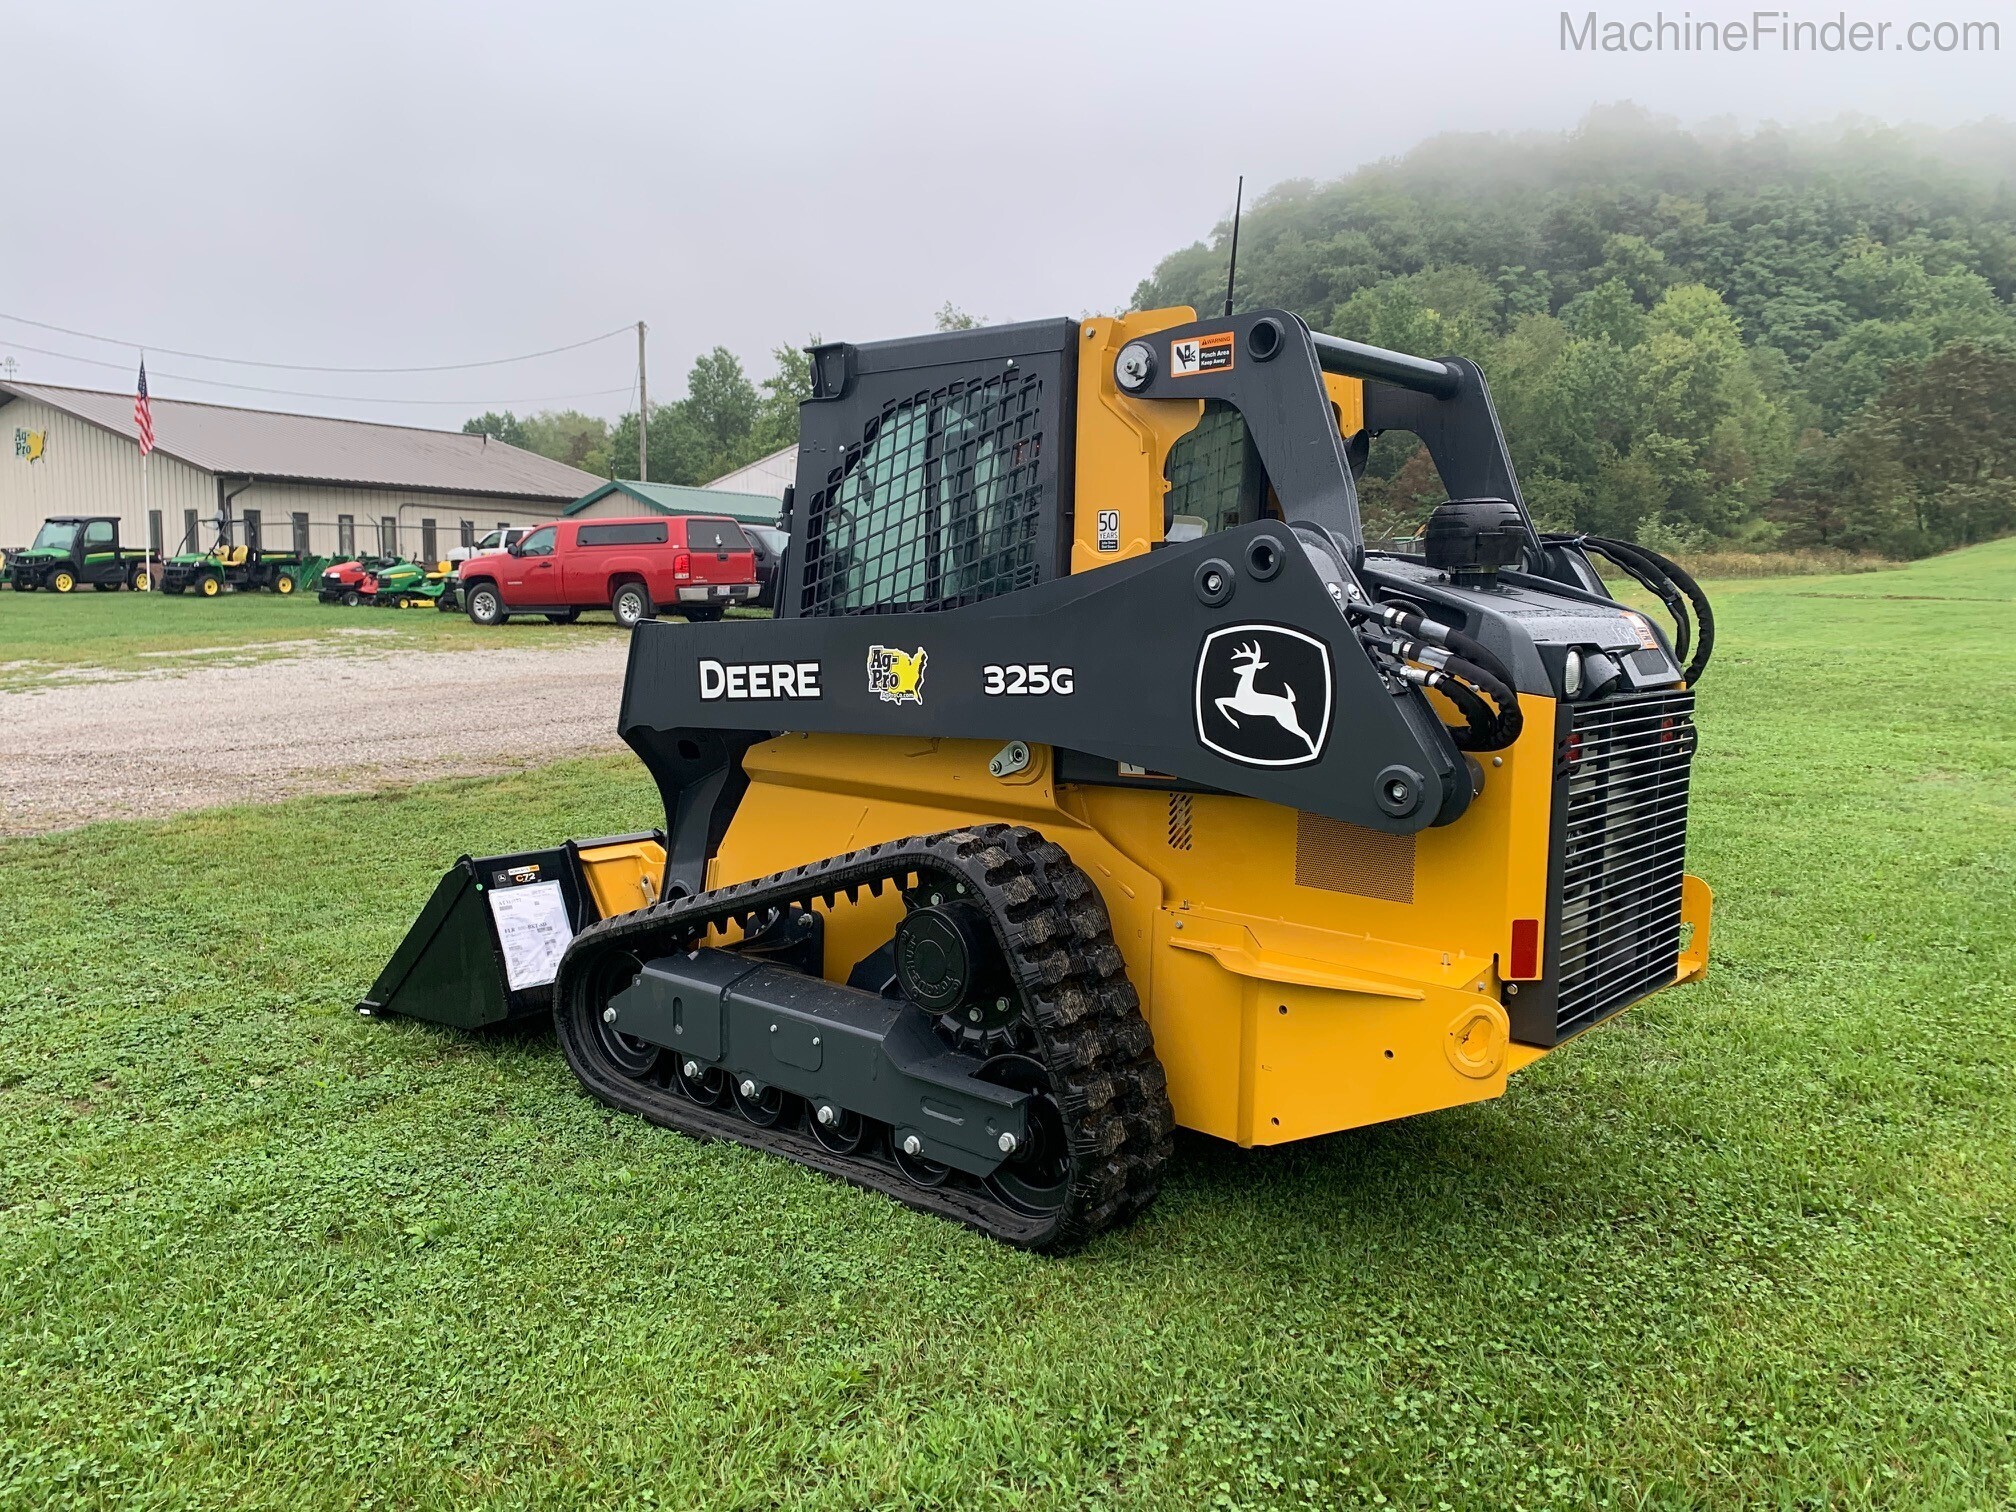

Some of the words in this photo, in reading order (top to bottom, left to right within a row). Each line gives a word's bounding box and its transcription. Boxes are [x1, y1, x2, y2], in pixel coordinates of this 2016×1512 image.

[1207, 336, 1231, 344] WARNING
[1201, 351, 1216, 359] Pinch
[16, 442, 31, 456] Pro
[1099, 512, 1118, 532] 50
[1100, 532, 1118, 540] YEARS
[871, 649, 898, 672] Ag-
[699, 660, 821, 699] DEERE
[872, 669, 899, 688] Pro
[983, 664, 1074, 695] 325G
[516, 872, 536, 882] C72
